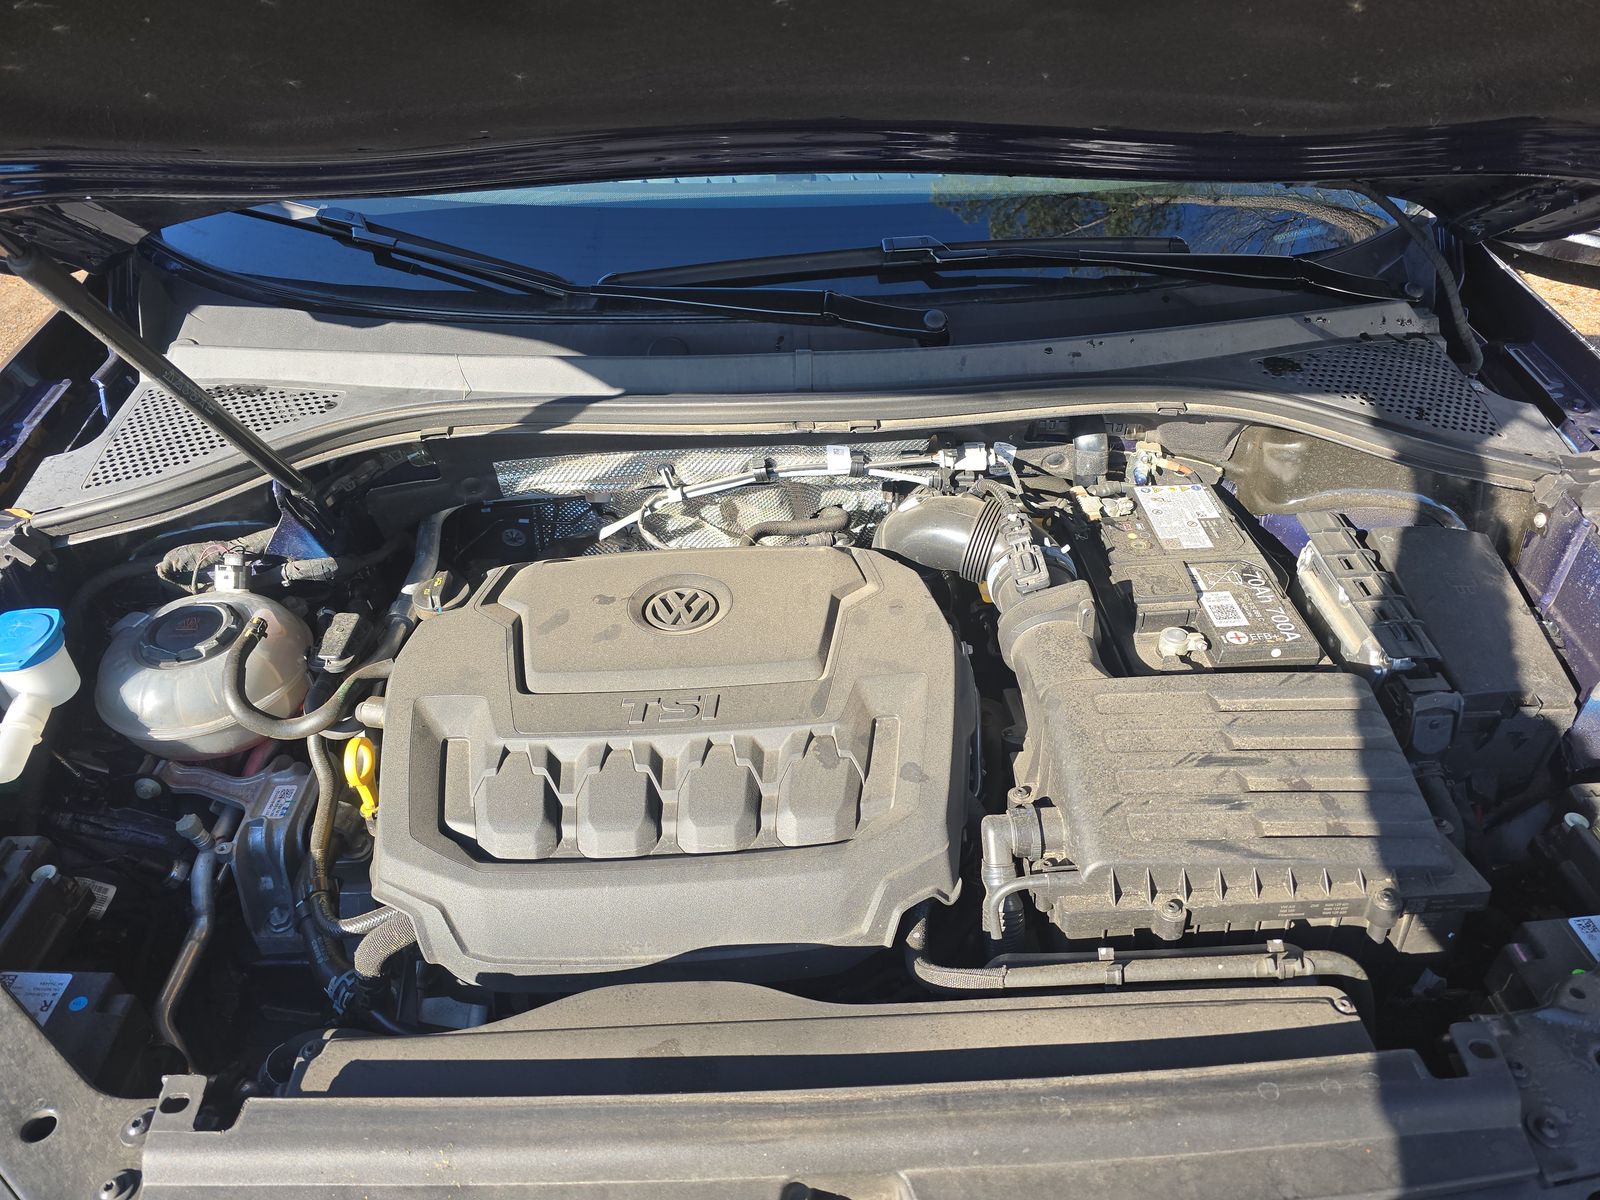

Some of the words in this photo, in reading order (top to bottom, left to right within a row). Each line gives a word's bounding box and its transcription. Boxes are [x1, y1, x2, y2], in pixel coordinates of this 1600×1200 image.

[642, 586, 720, 632] VW
[1242, 571, 1274, 603] 70Ah
[1265, 607, 1301, 642] 700A
[621, 693, 721, 724] TSI
